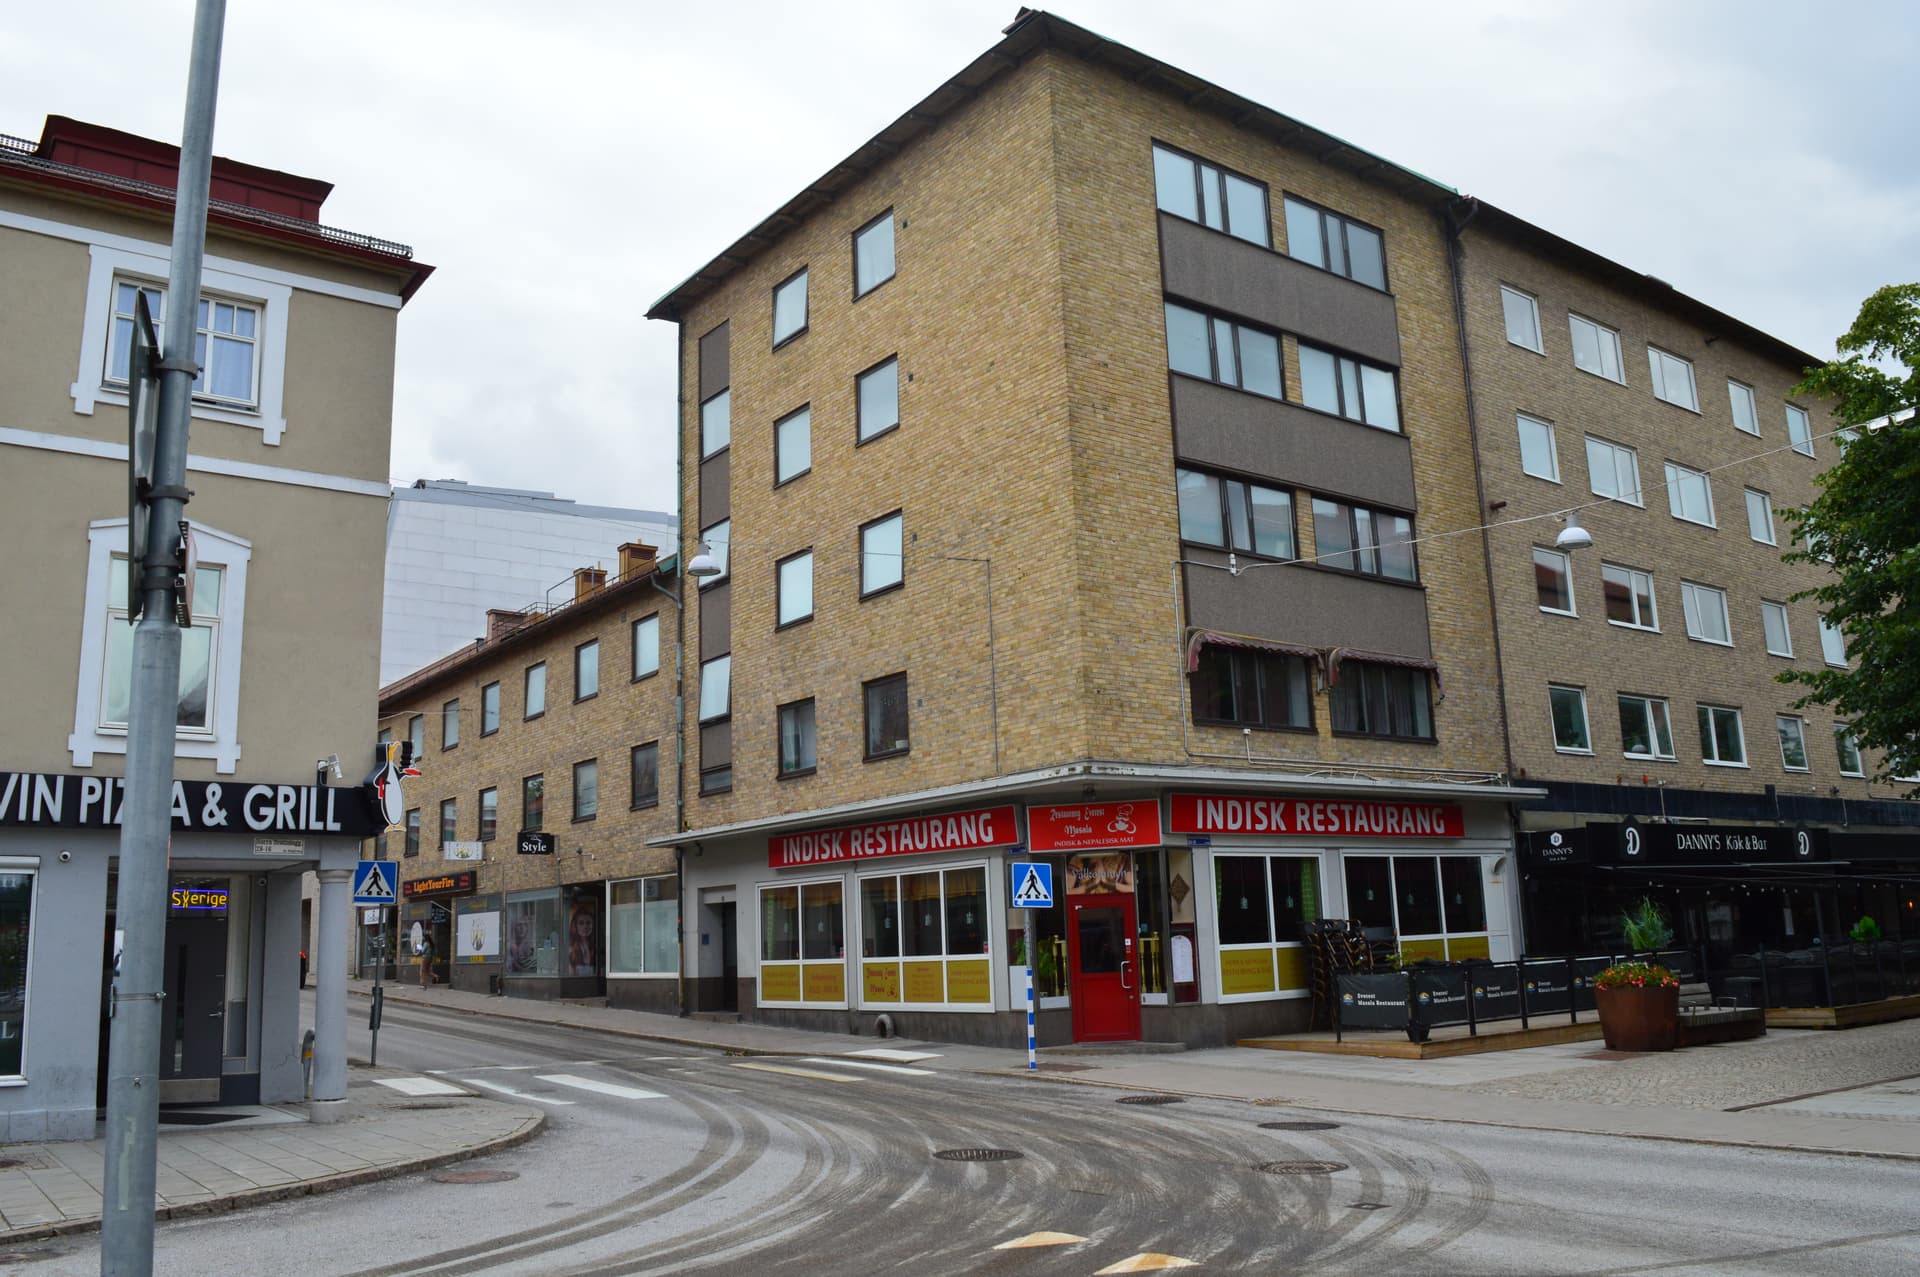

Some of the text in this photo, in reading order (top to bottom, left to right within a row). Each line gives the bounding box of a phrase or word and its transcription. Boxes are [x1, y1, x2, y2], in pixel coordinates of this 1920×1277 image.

[79, 776, 192, 827] PIA
[201, 782, 229, 827] &
[243, 784, 341, 831] GRILL
[1196, 798, 1446, 834] INDISK RESTAURANG
[522, 841, 547, 854] Style
[783, 813, 994, 863] INDISK RESTAURANG
[1054, 839, 1076, 847] INDISK
[1119, 835, 1135, 843] MAT
[171, 889, 228, 908] Sverige
